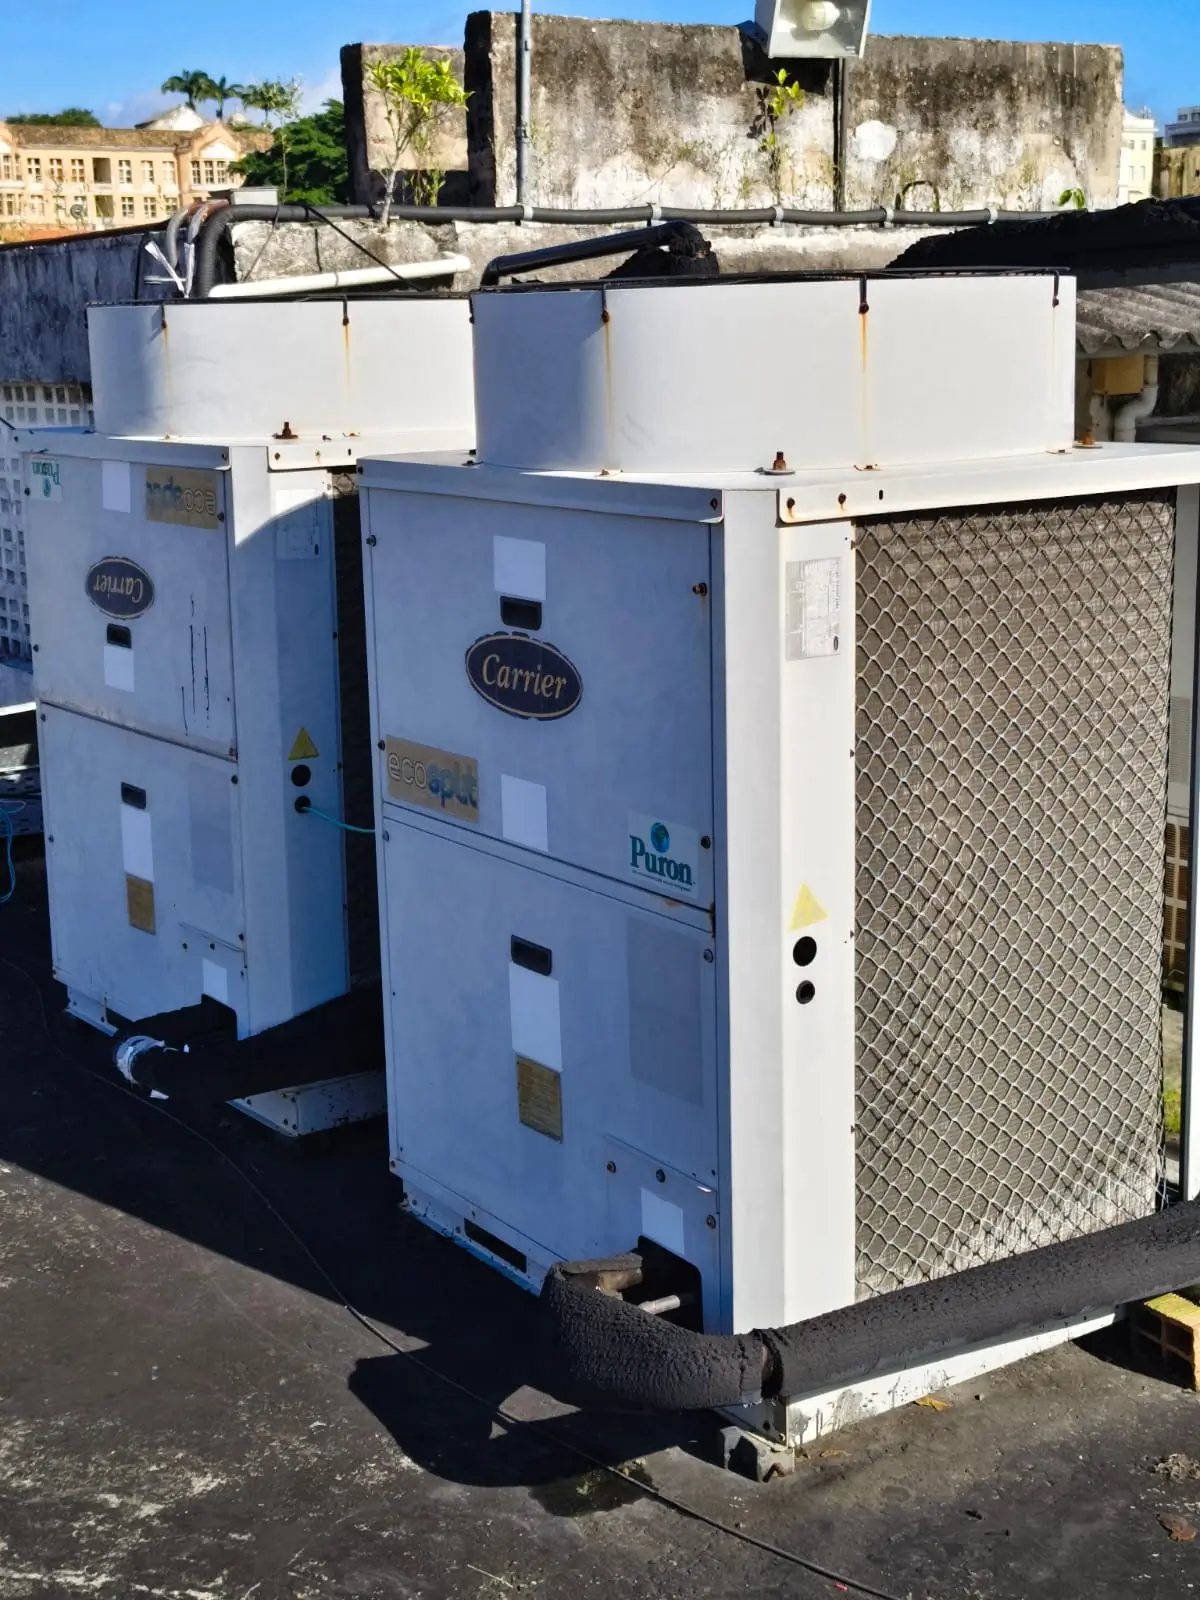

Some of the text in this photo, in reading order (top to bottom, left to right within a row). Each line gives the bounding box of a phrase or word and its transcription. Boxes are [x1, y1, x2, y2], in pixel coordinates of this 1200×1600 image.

[93, 574, 143, 604] Carrier
[482, 653, 567, 699] Carrier
[629, 834, 693, 887] Puron
